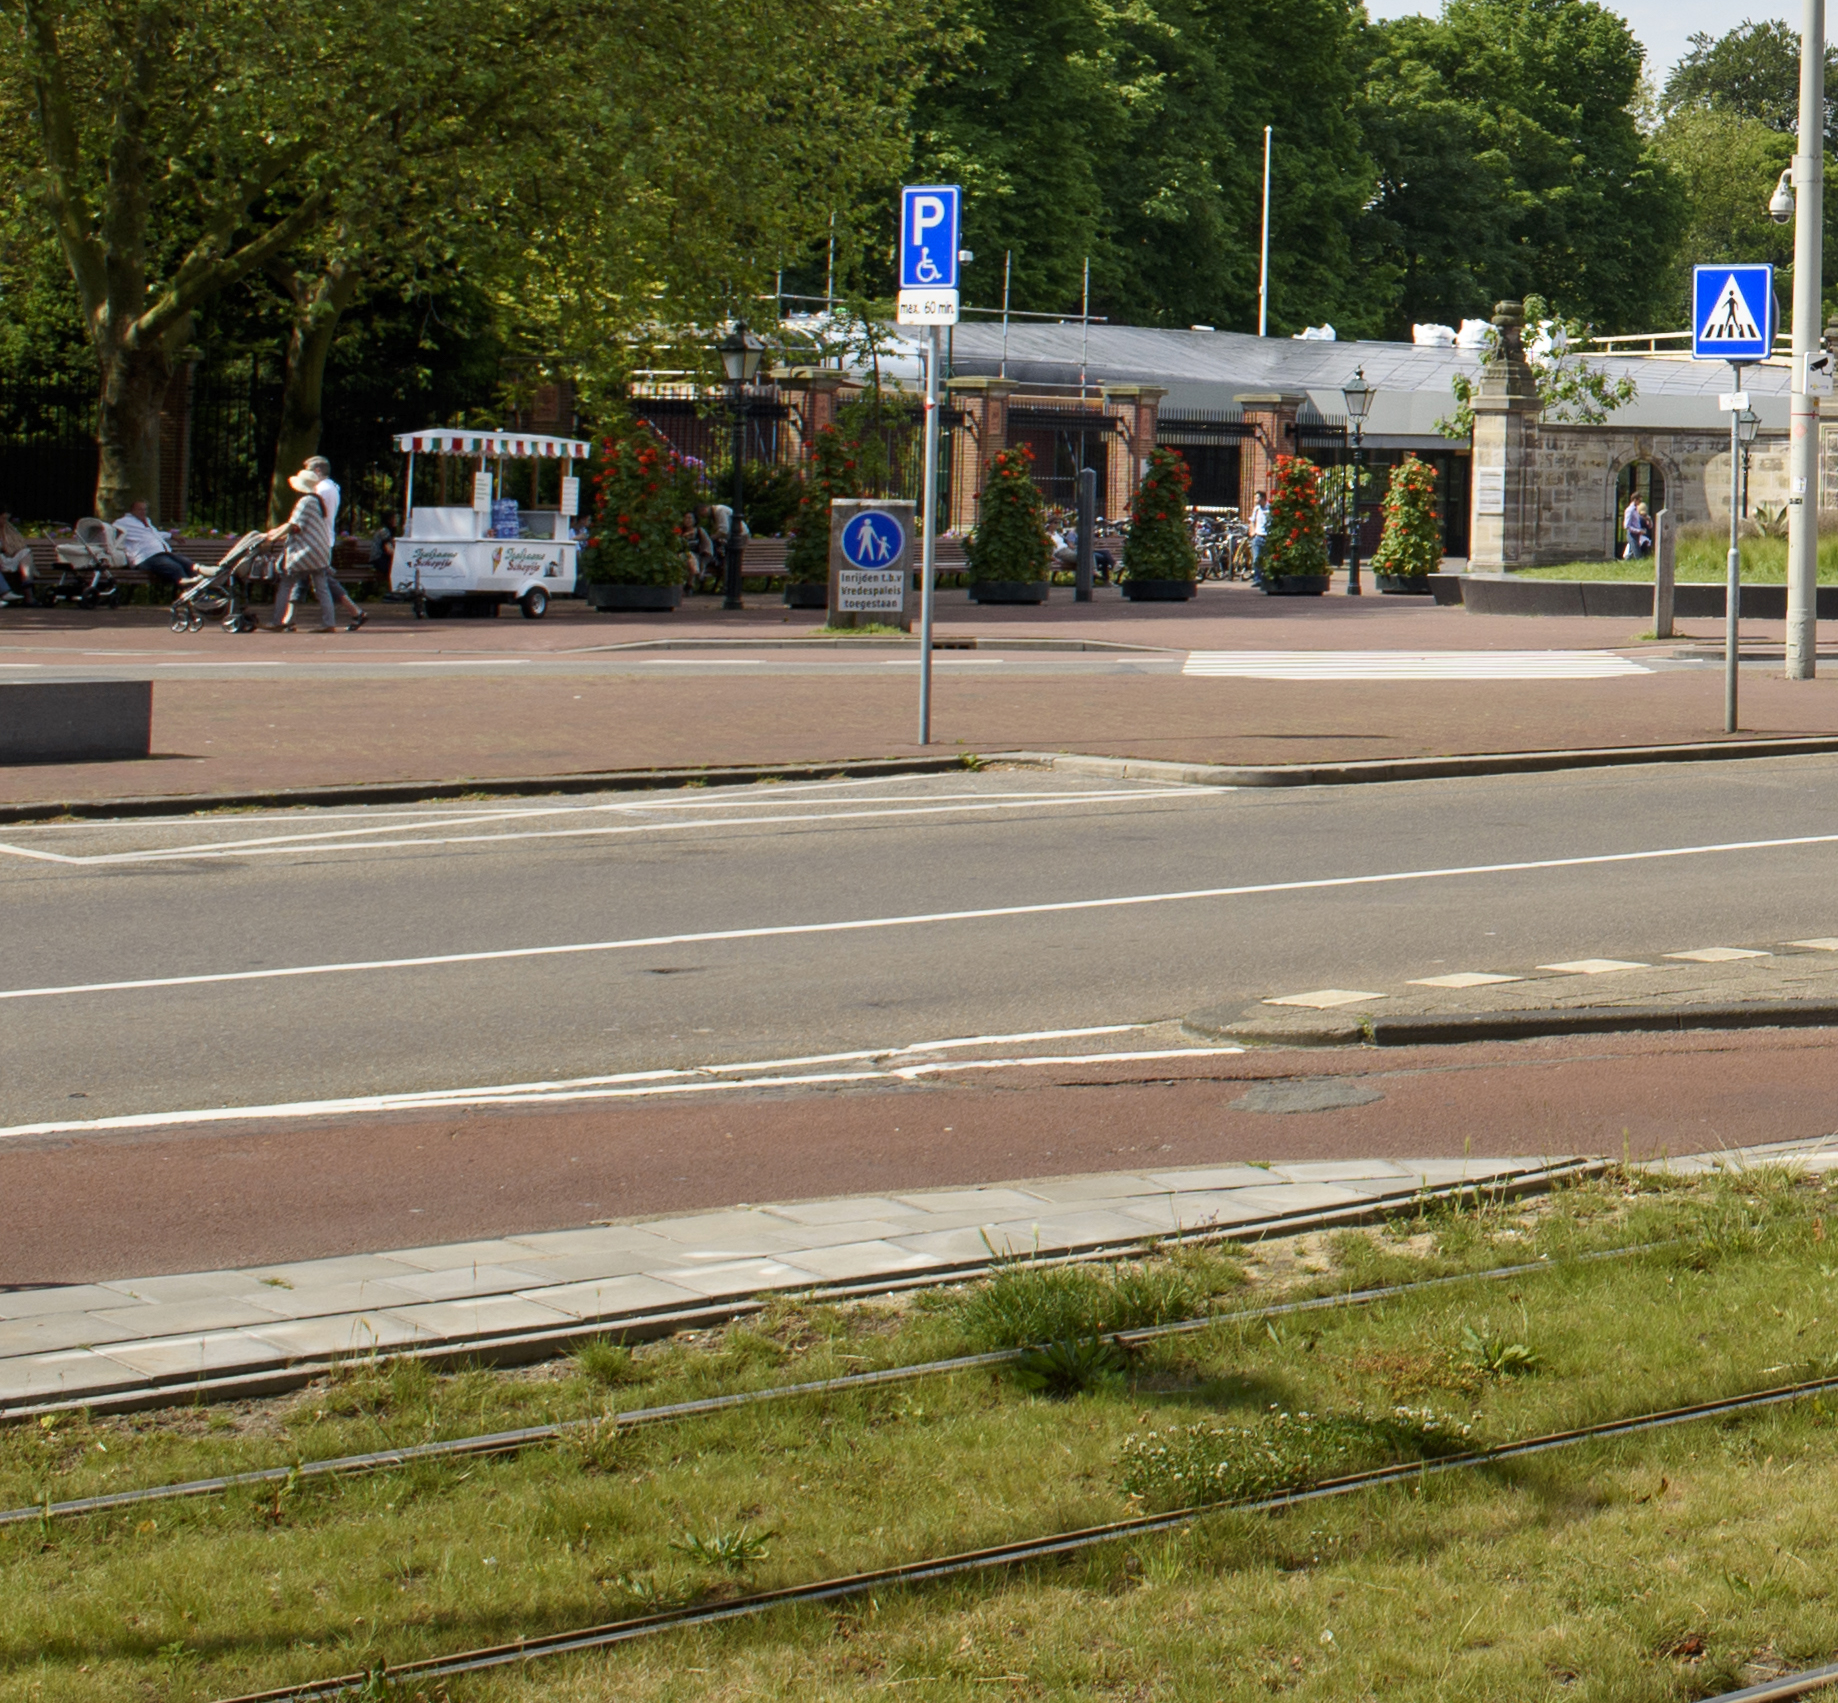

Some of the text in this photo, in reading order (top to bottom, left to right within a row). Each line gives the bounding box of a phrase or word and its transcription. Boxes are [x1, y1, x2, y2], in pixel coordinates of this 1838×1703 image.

[913, 196, 945, 246] P
[900, 301, 955, 315] max. 60 min.
[841, 572, 879, 585] Inrijden
[841, 586, 901, 597] Vredespaleis
[844, 600, 898, 610] toegestaan
